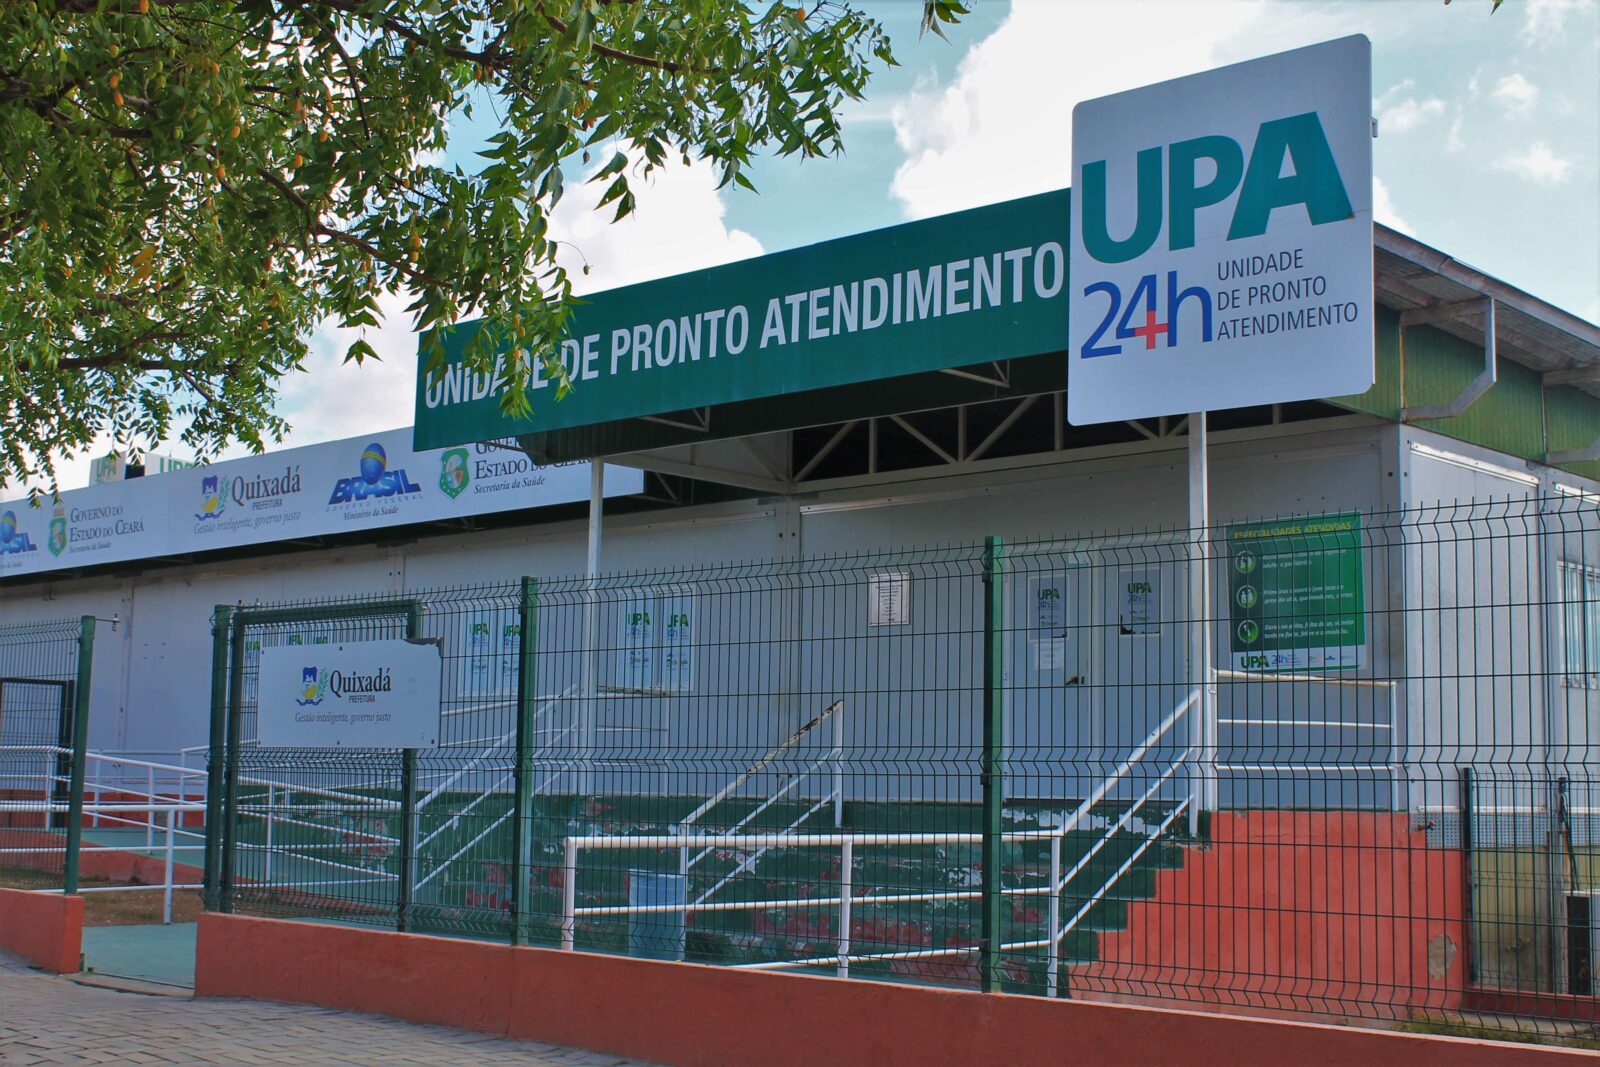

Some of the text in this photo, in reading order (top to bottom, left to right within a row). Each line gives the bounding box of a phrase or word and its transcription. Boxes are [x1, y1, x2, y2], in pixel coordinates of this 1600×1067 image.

[1081, 111, 1356, 264] UPA
[1217, 249, 1304, 281] UNIDADE
[1217, 275, 1327, 311] DE PRONTO
[560, 333, 601, 384] DE
[609, 304, 750, 375] PRONTO
[759, 241, 1065, 349] ATENDIMENTO
[1080, 270, 1213, 359] 24h
[1216, 301, 1359, 341] ATENDIMENTO
[231, 465, 301, 507] Quixadá
[328, 469, 422, 505] BRASIL
[474, 476, 546, 494] Secretaria da Saúde
[252, 499, 284, 510] PREFEITURA
[380, 505, 399, 516] Saúde
[1037, 588, 1061, 601] UPA
[1127, 582, 1152, 594] UPA
[1240, 655, 1270, 669] UPA
[330, 667, 392, 698] Quixadá
